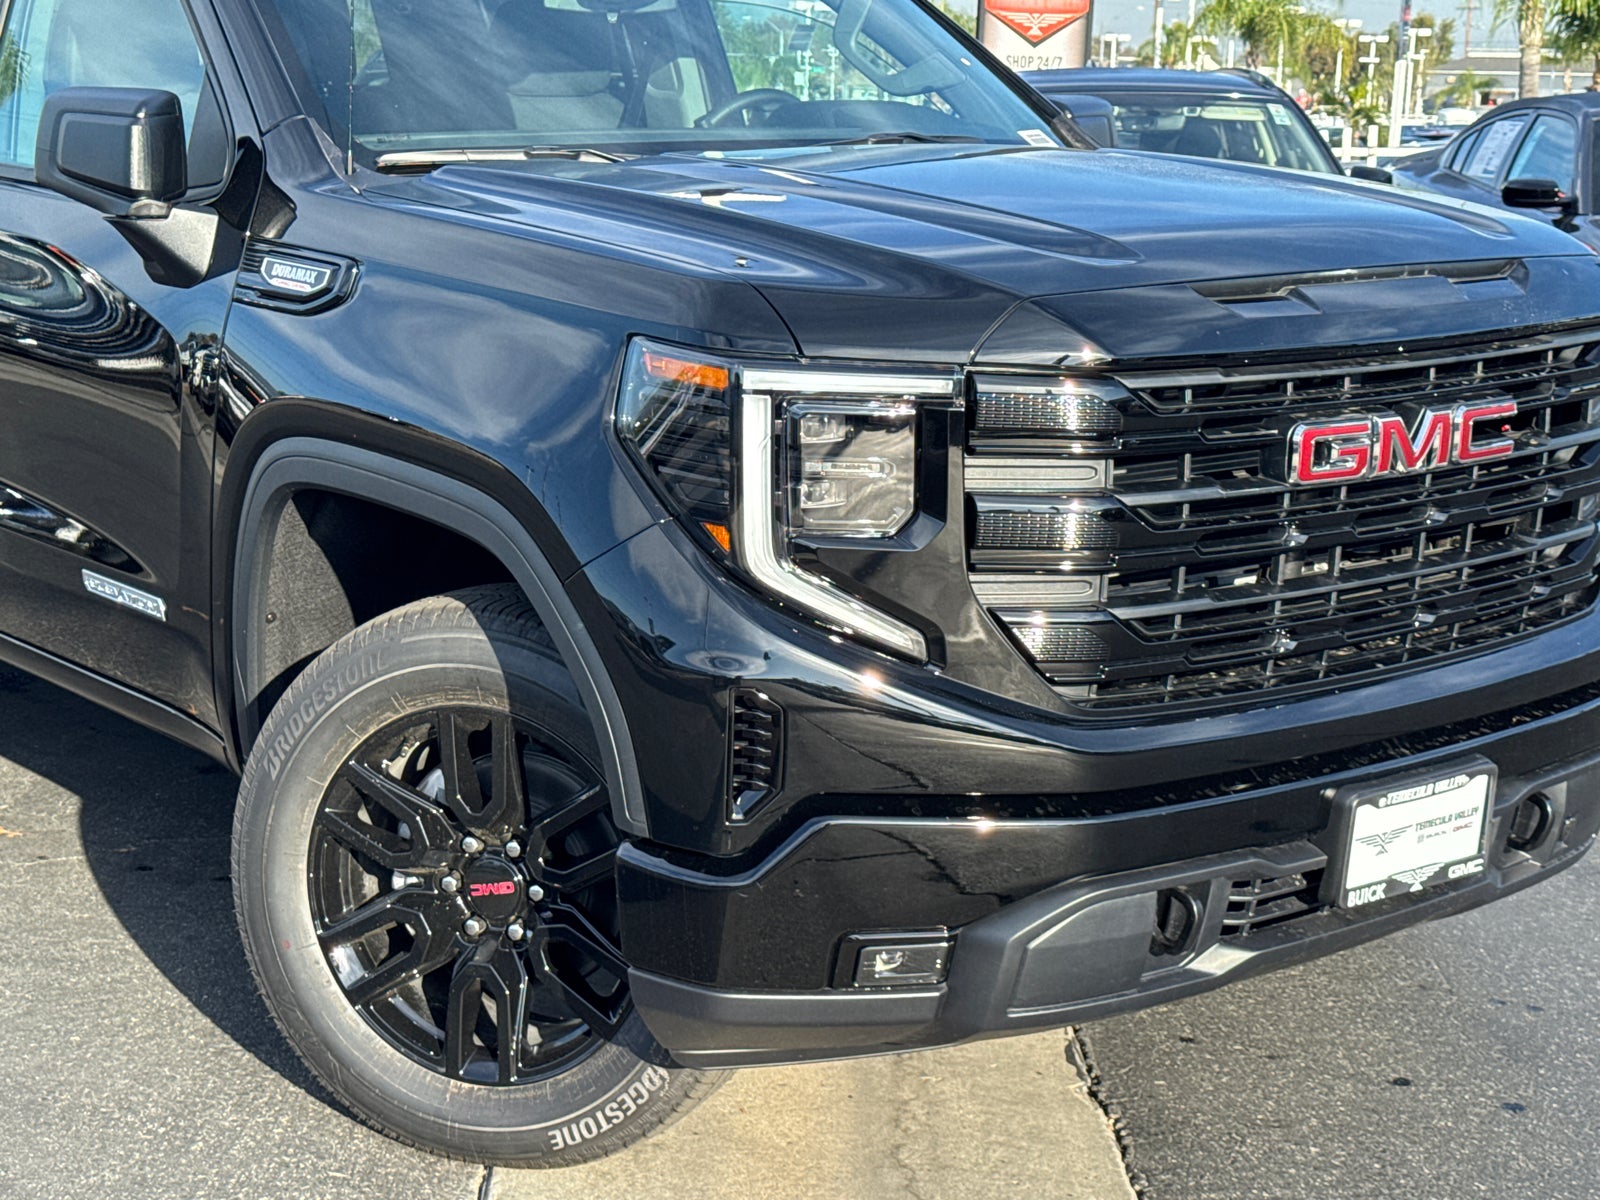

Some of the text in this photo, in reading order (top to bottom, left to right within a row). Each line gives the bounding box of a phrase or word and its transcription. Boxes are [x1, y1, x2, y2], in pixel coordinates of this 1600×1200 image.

[1006, 55, 1063, 69] SHOP 24/7
[271, 263, 318, 284] DURAMAX
[1288, 399, 1518, 485] GMC
[469, 881, 515, 896] GMC
[1347, 858, 1484, 908] BUICK GMC
